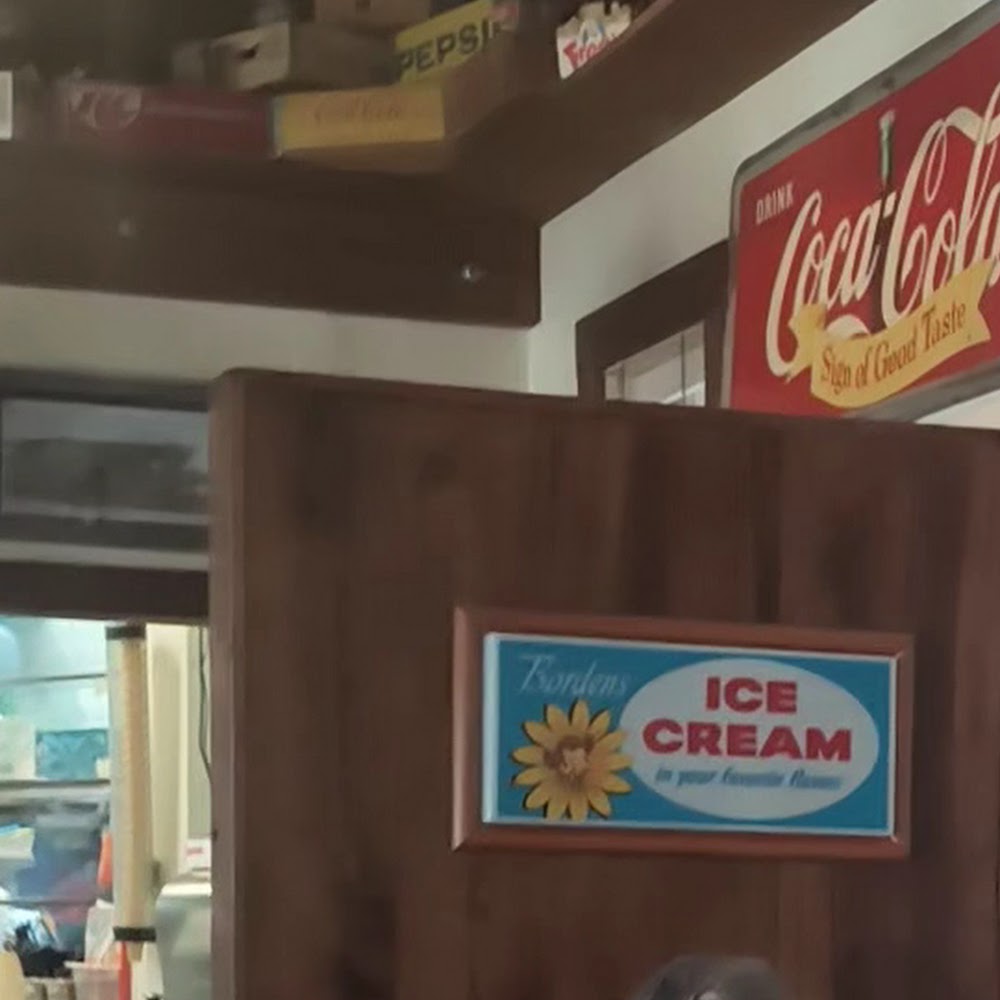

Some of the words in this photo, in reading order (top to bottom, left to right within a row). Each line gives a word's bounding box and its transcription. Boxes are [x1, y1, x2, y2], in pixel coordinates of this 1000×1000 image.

[399, 18, 489, 75] PEPSI
[756, 181, 794, 225] DRINK
[820, 344, 850, 395] Sign
[854, 349, 872, 389] of
[873, 336, 918, 383] Good
[920, 303, 967, 351] Taste
[705, 676, 798, 714] ICE
[642, 718, 853, 762] CREAM
